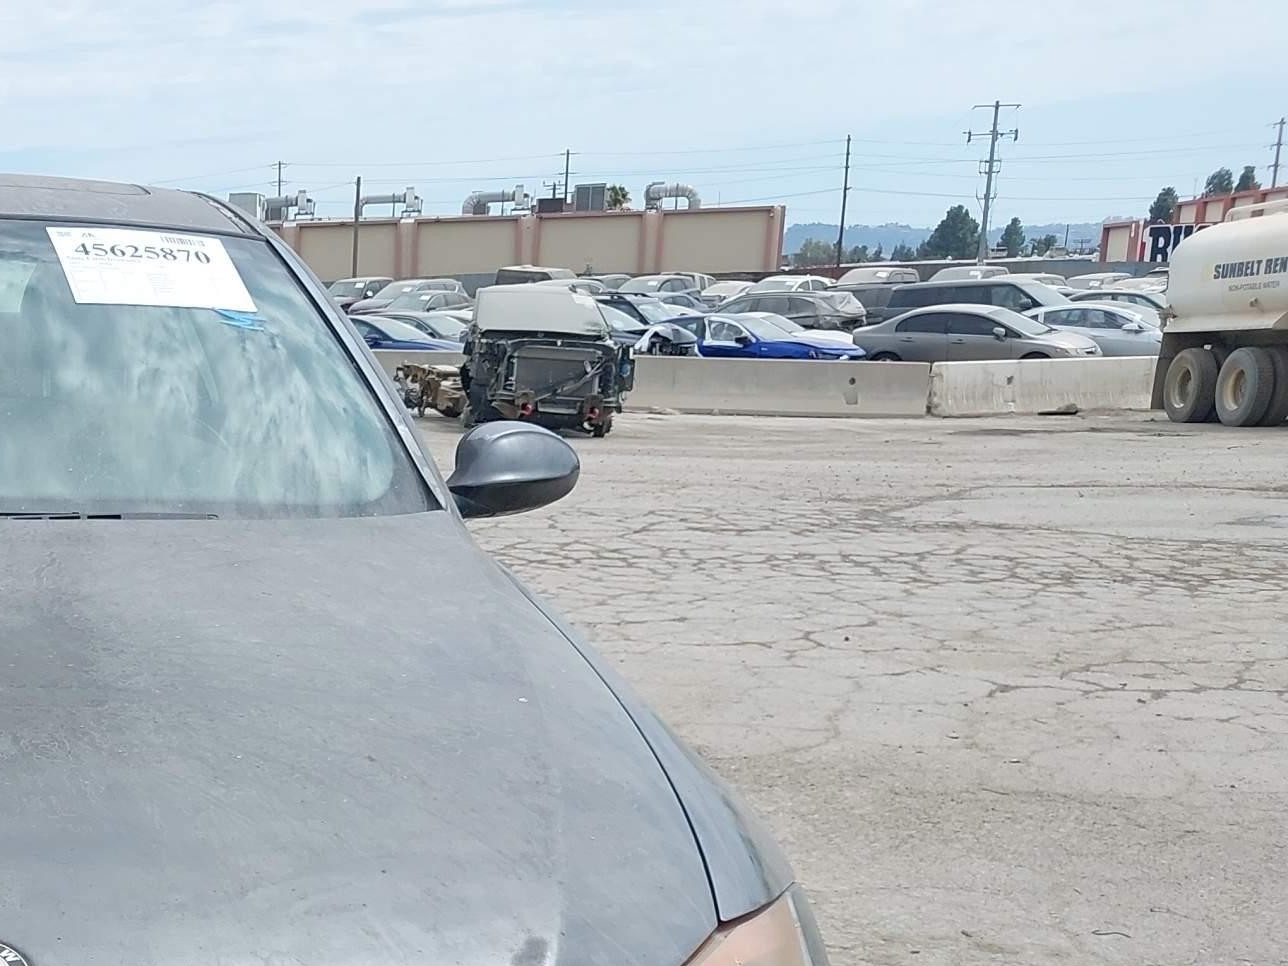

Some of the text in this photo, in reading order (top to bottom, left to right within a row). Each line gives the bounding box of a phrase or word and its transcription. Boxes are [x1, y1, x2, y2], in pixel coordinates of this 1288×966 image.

[74, 242, 211, 265] 45625870
[1144, 224, 1212, 262] RU
[1213, 259, 1263, 279] SUNBELT
[1263, 280, 1280, 289] WATER
